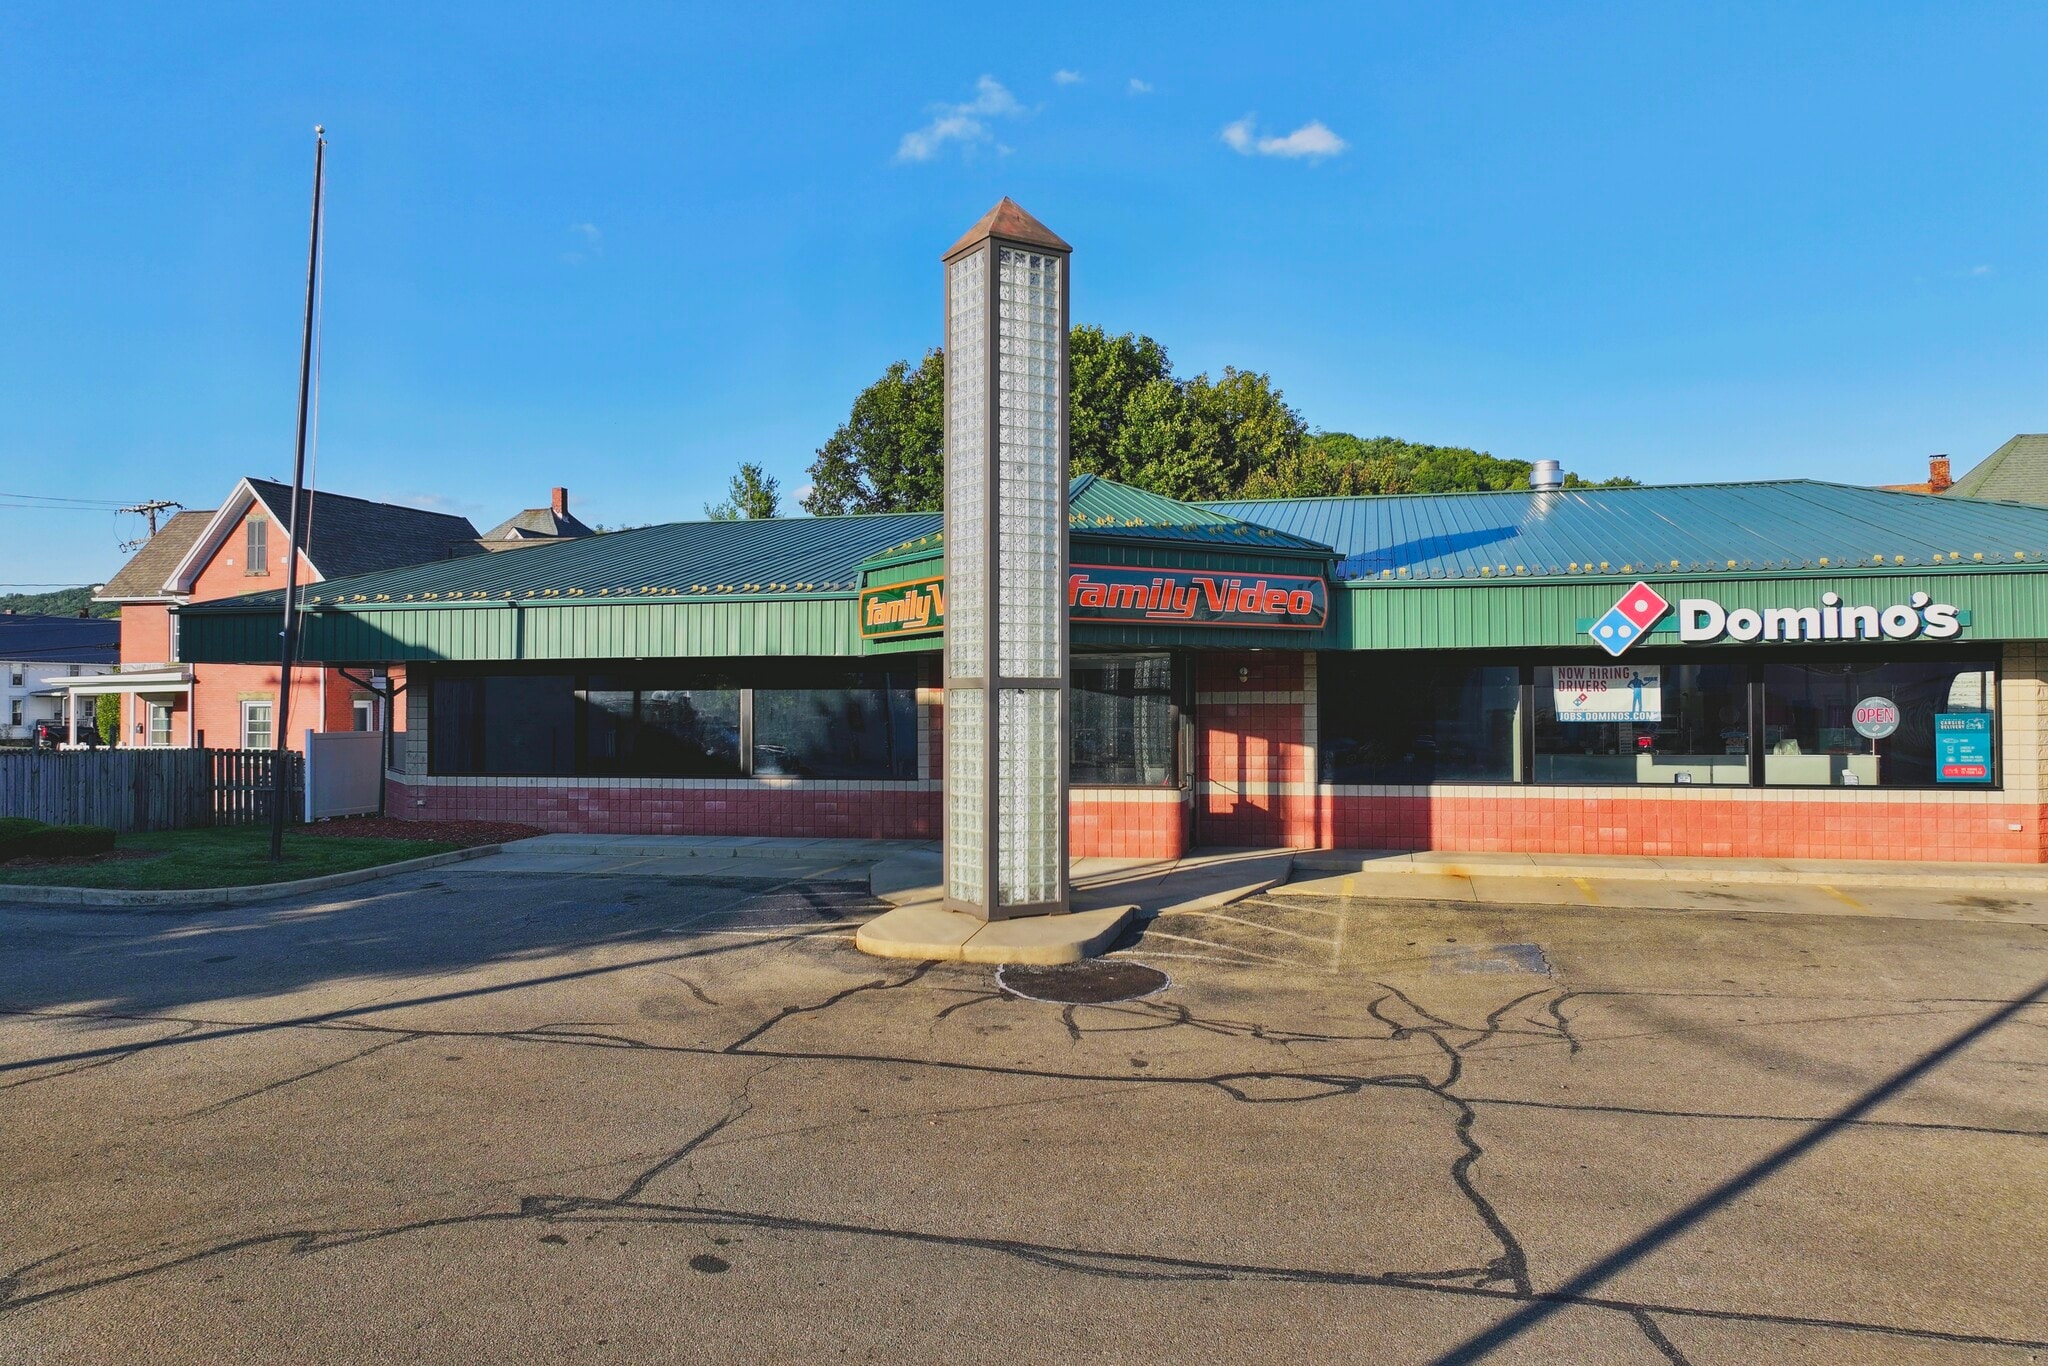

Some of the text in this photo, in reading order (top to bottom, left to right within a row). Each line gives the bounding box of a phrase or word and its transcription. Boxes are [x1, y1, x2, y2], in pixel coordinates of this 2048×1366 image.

[1069, 574, 1313, 618] family Video
[866, 590, 931, 628] family
[1679, 591, 1960, 641] Domino's
[1558, 667, 1630, 679] NOW HIRING
[1558, 680, 1607, 692] DRIVERS
[1559, 711, 1654, 721] JOBS.DOMINOS.COM
[1856, 708, 1894, 723] OPEN
